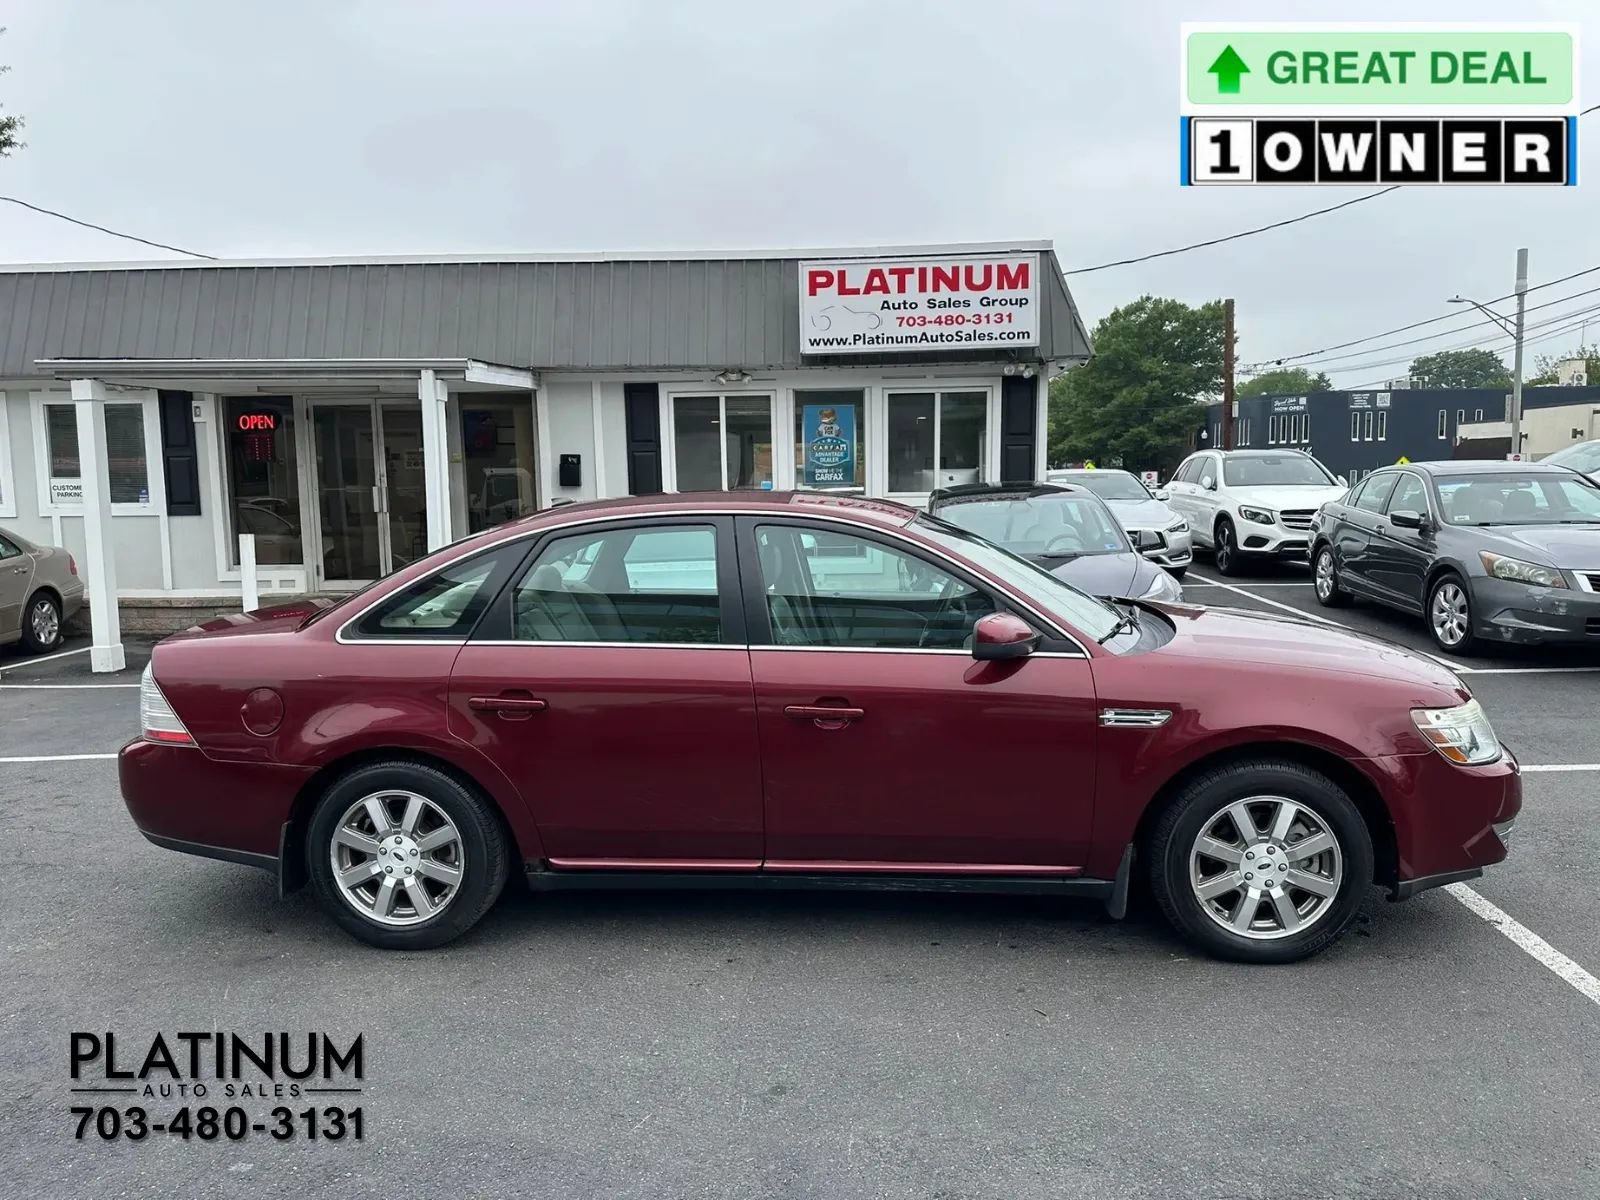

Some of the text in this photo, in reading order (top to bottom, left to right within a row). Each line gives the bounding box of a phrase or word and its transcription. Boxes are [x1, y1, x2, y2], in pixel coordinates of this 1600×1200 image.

[808, 263, 1030, 297] PLATINUM
[880, 296, 1029, 311] Auto Sales Group
[896, 312, 1013, 328] 703-480-3131
[808, 329, 1031, 347] www.PlatinumAutoSales.com
[239, 415, 274, 430] OPEN
